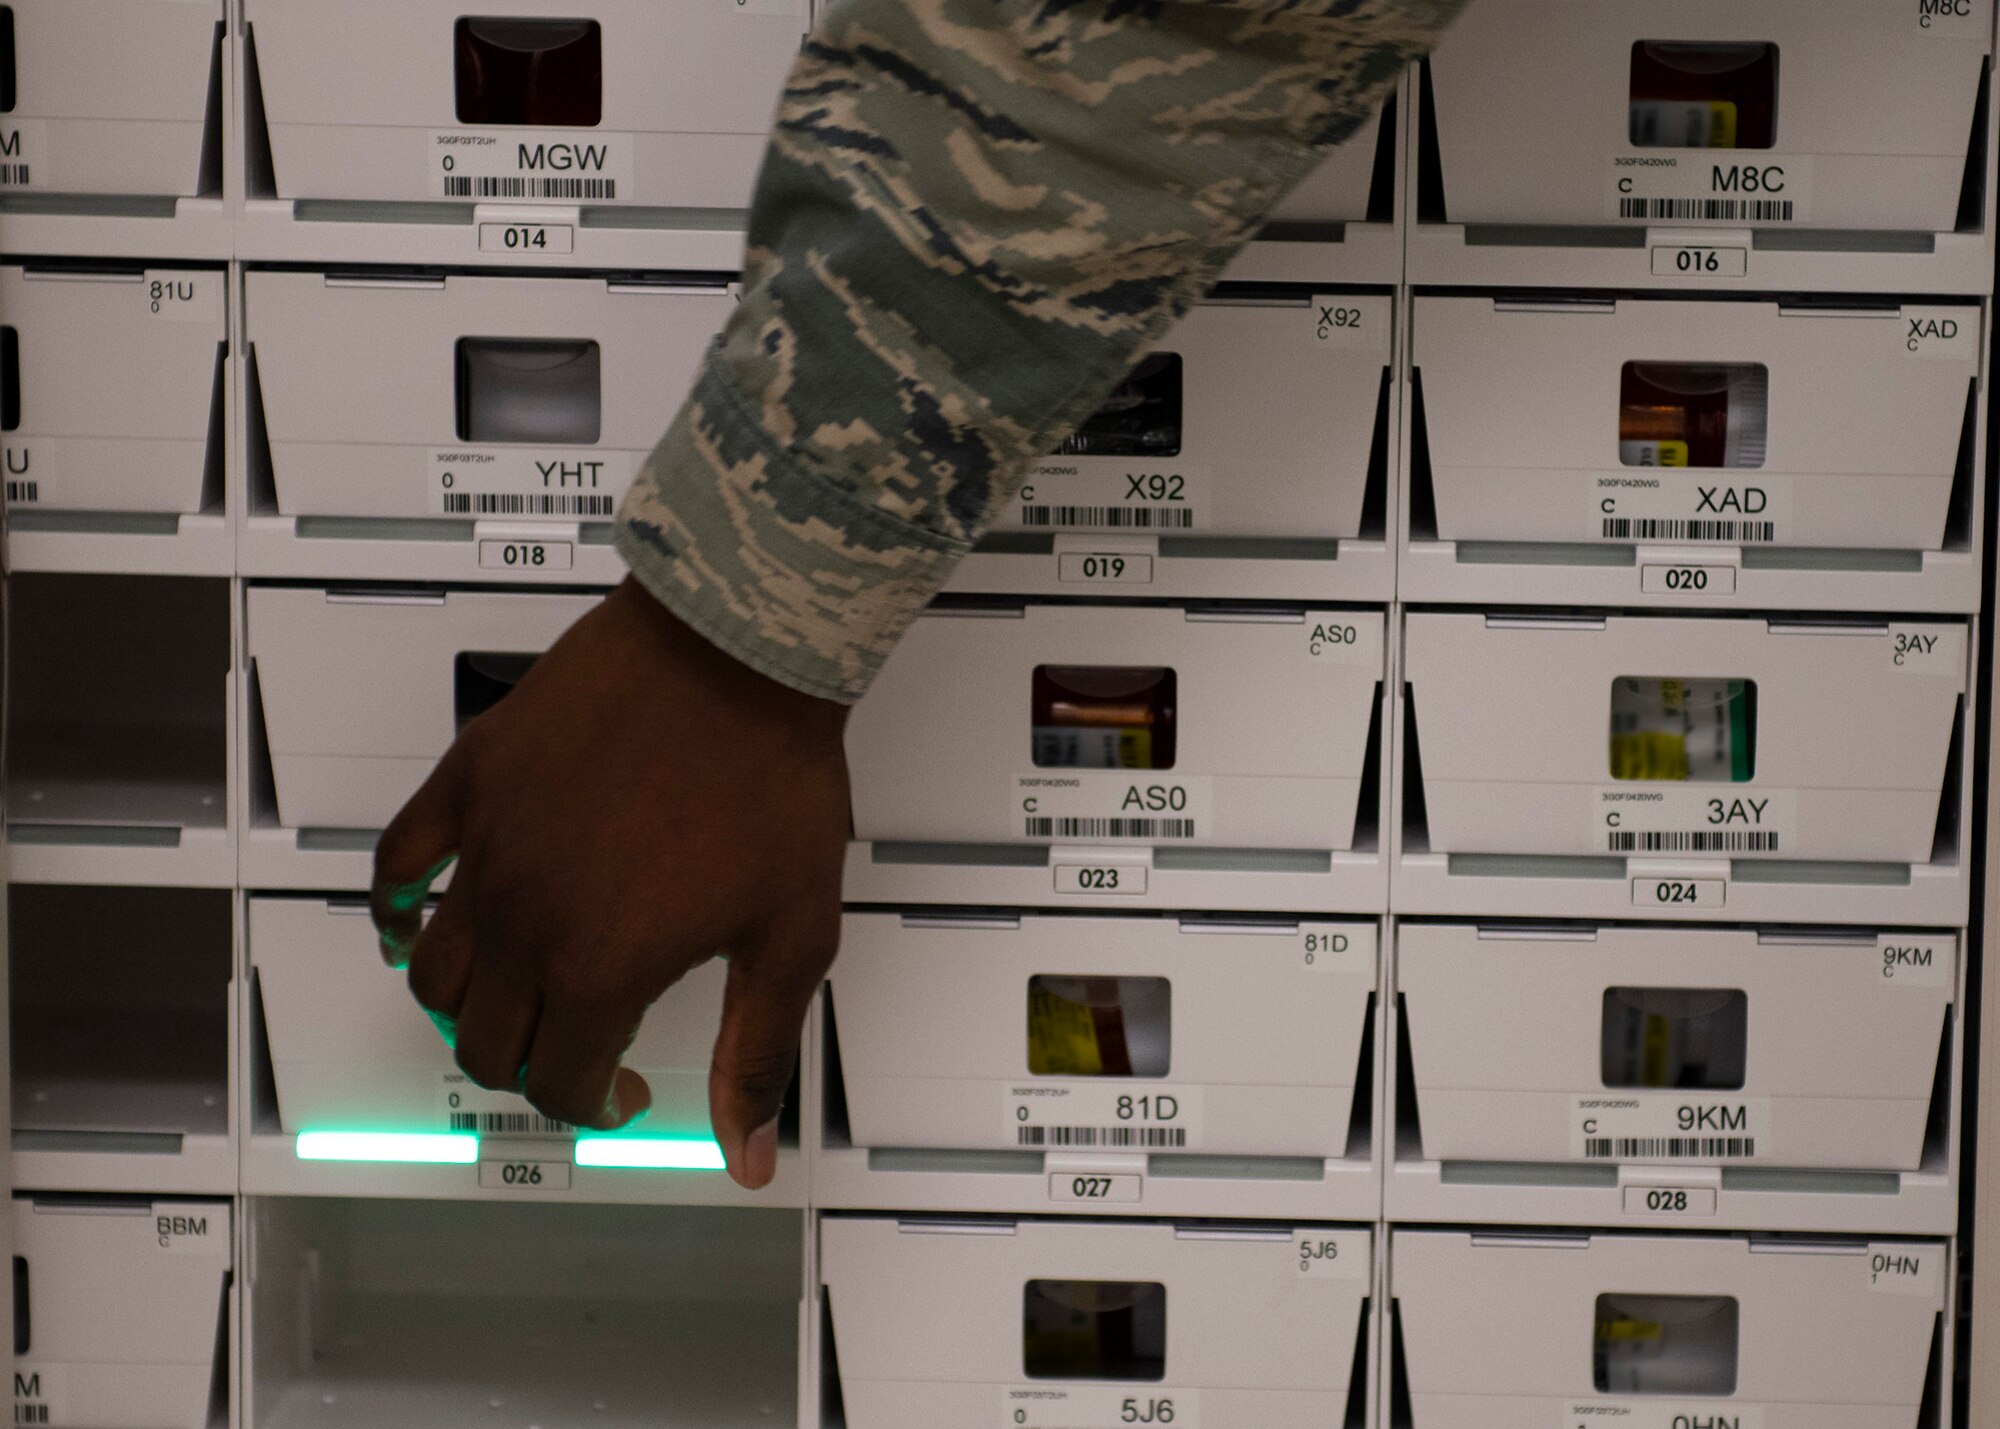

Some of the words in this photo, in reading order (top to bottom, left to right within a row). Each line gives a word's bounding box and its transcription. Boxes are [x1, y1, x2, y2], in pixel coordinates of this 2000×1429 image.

[1919, 0, 1970, 16] M8C
[1920, 15, 1930, 28] C
[519, 144, 606, 170] MGW
[1618, 178, 1632, 193] C
[1713, 166, 1784, 192] M8C
[505, 228, 546, 247] 014
[1676, 253, 1718, 271] 016
[150, 281, 192, 300] 81U
[1318, 307, 1360, 327] X92
[1317, 326, 1328, 339] C
[1907, 319, 1957, 338] XAD
[1907, 338, 1917, 351] C
[7, 448, 28, 474] U
[536, 462, 604, 487] YHT
[1020, 487, 1034, 501] C
[1125, 474, 1184, 500] X92
[1601, 499, 1615, 513] C
[1697, 487, 1766, 513] XAD
[504, 545, 544, 565] 018
[1083, 557, 1124, 577] 019
[1666, 568, 1707, 589] 020
[1310, 643, 1320, 655] C
[1895, 634, 1937, 653] 3AY
[1894, 651, 1904, 665] C
[1023, 798, 1037, 812] C
[1122, 786, 1186, 811] AS0
[1607, 813, 1620, 827] C
[1708, 799, 1768, 824] 3AY
[1079, 869, 1118, 888] 023
[1657, 883, 1696, 902] 024
[1305, 934, 1348, 952] 81D
[1884, 947, 1932, 966] 9KM
[1883, 965, 1893, 977] C
[1117, 1096, 1178, 1120] 81D
[1583, 1120, 1596, 1134] C
[1678, 1106, 1746, 1130] 9KM
[503, 1164, 541, 1184] 026
[1073, 1178, 1112, 1197] 027
[1646, 1190, 1687, 1210] 028
[157, 1217, 206, 1235] BBM
[1300, 1241, 1337, 1259] 5J6
[15, 1373, 39, 1397] M
[1122, 1399, 1174, 1423] 5J6
